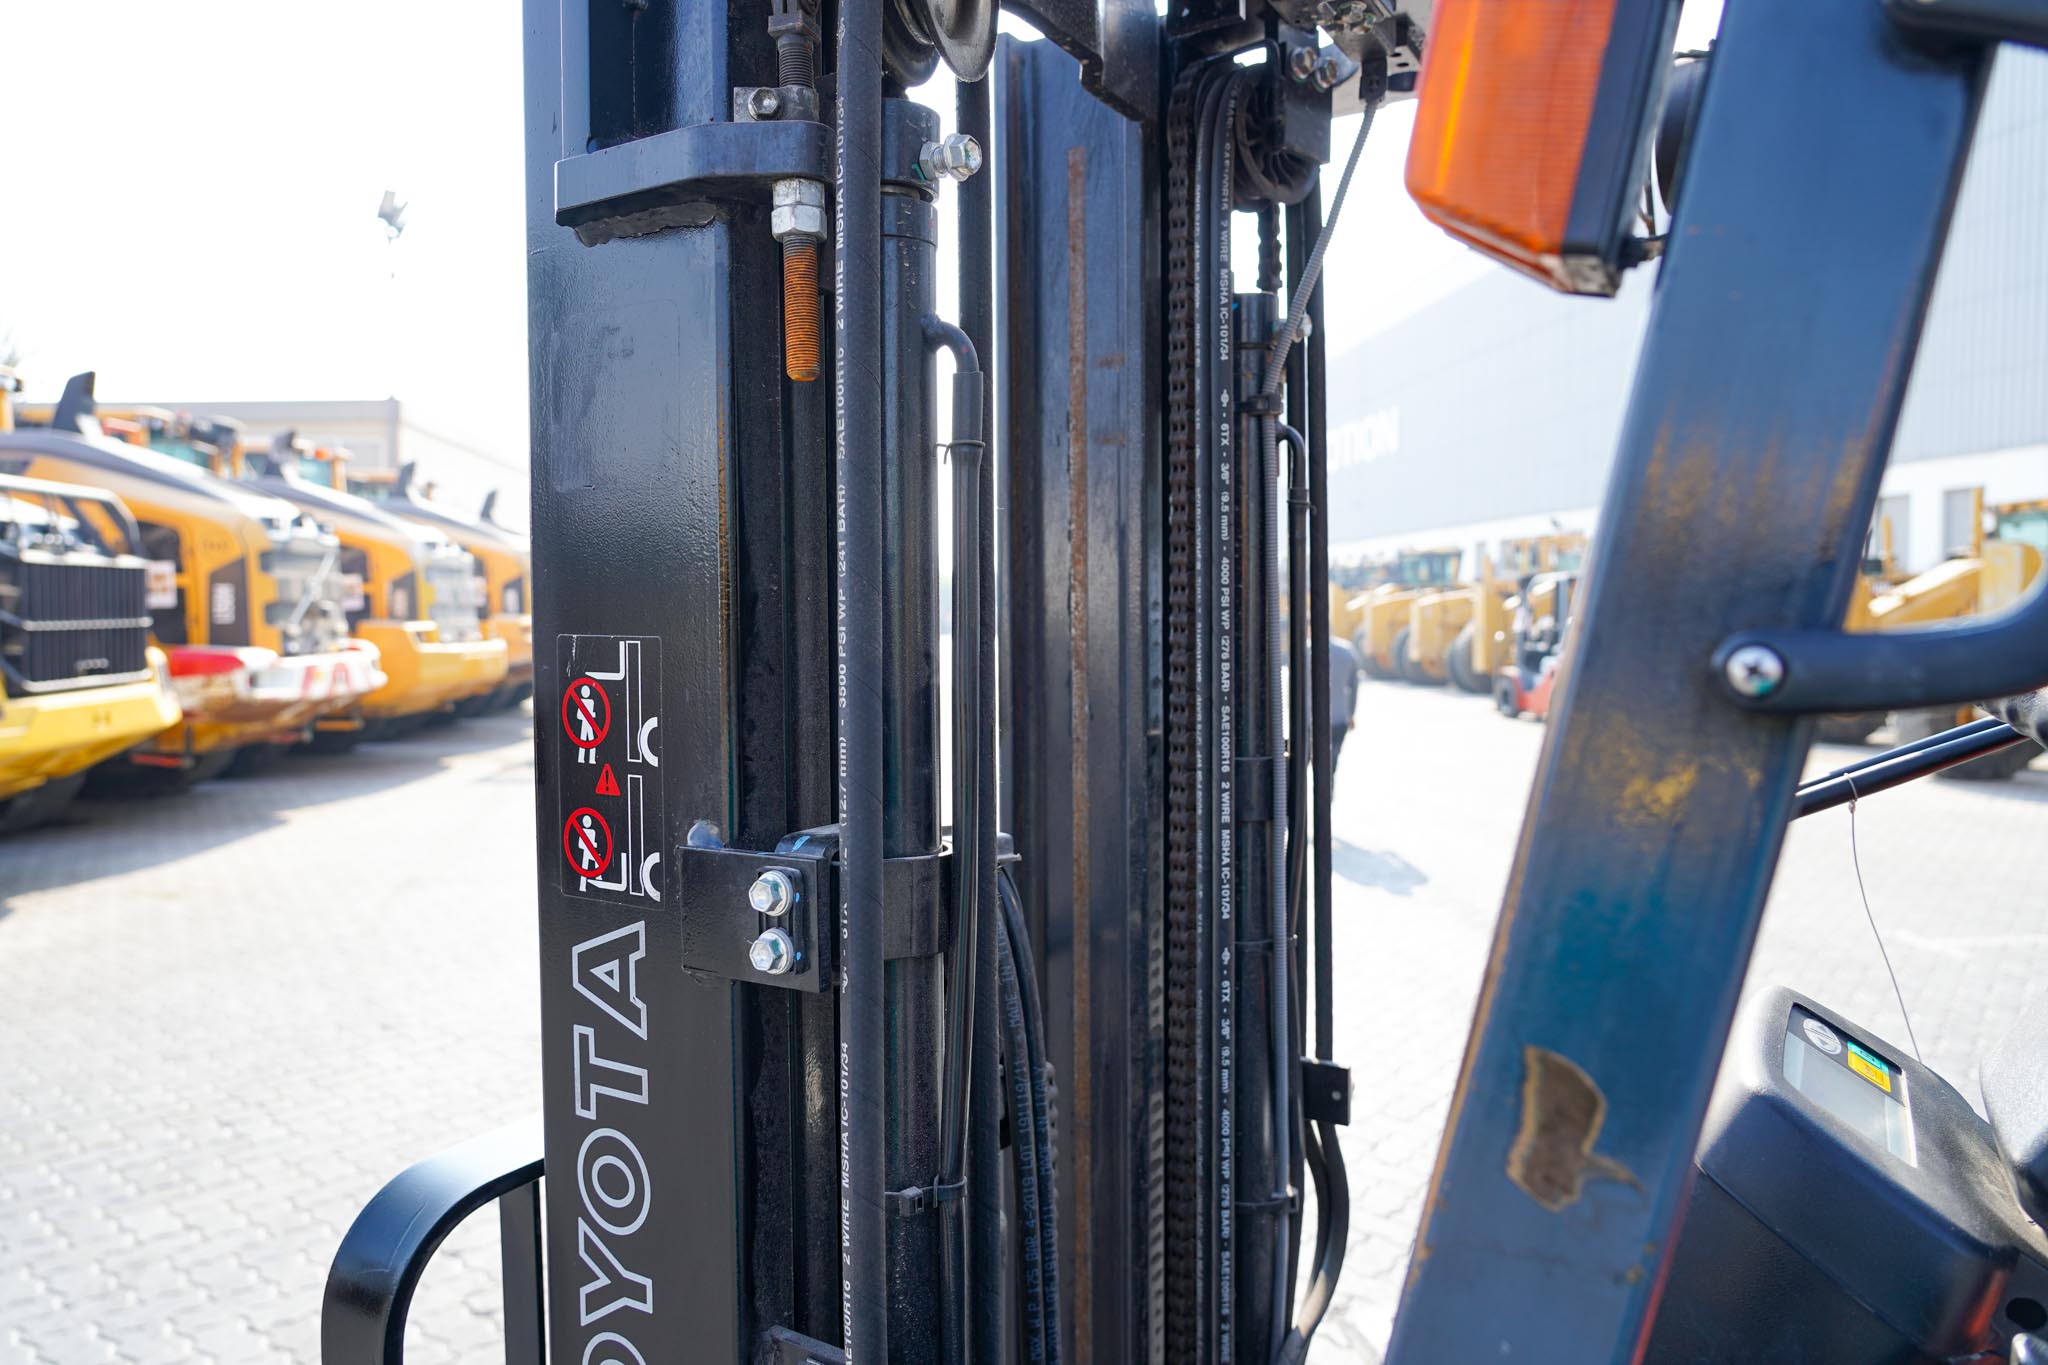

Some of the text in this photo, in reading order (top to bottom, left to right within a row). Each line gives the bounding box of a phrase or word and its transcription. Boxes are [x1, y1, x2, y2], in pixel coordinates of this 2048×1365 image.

[836, 188, 845, 250] MSHA
[1220, 231, 1229, 262] WIRE
[1220, 268, 1230, 304] MSHA
[836, 317, 845, 330] 2
[1220, 307, 1230, 361] IC-101/34
[1220, 423, 1230, 446] 6TX
[1220, 462, 1230, 485] 3/8"
[836, 484, 846, 533] BAR)
[1220, 490, 1230, 513] (9.5
[1220, 515, 1230, 541] mm)
[836, 541, 846, 578] (241
[1220, 556, 1230, 585] 4000
[837, 588, 846, 621] WP
[1220, 587, 1230, 607] PSI
[1220, 609, 1230, 630] WP
[838, 626, 847, 658] PSI
[1220, 635, 1230, 660] (276
[838, 663, 847, 709] 3500
[1220, 662, 1230, 693] BAR)
[1220, 705, 1230, 773] SAE100R16
[838, 736, 847, 778] mm)
[1220, 781, 1230, 789] 2
[1220, 791, 1230, 824] WIRE
[1220, 829, 1230, 865] MSHA
[1221, 867, 1231, 920] IC-101/34
[1001, 964, 1014, 983] IN
[1221, 979, 1230, 1003] 6TX
[1006, 992, 1022, 1028] MADE
[1221, 1018, 1230, 1040] 3/8"
[1221, 1045, 1230, 1066] (9.5
[840, 1041, 849, 1127] IC-101/34
[1221, 1068, 1230, 1093] mm)
[1221, 1108, 1230, 1135] 4000
[840, 1132, 850, 1189] MSHA
[1020, 1143, 1034, 1169] LOT
[1221, 1137, 1230, 1157] PSI
[1221, 1159, 1230, 1179] WP
[841, 1198, 850, 1248] WIRE
[842, 1253, 851, 1266] 2
